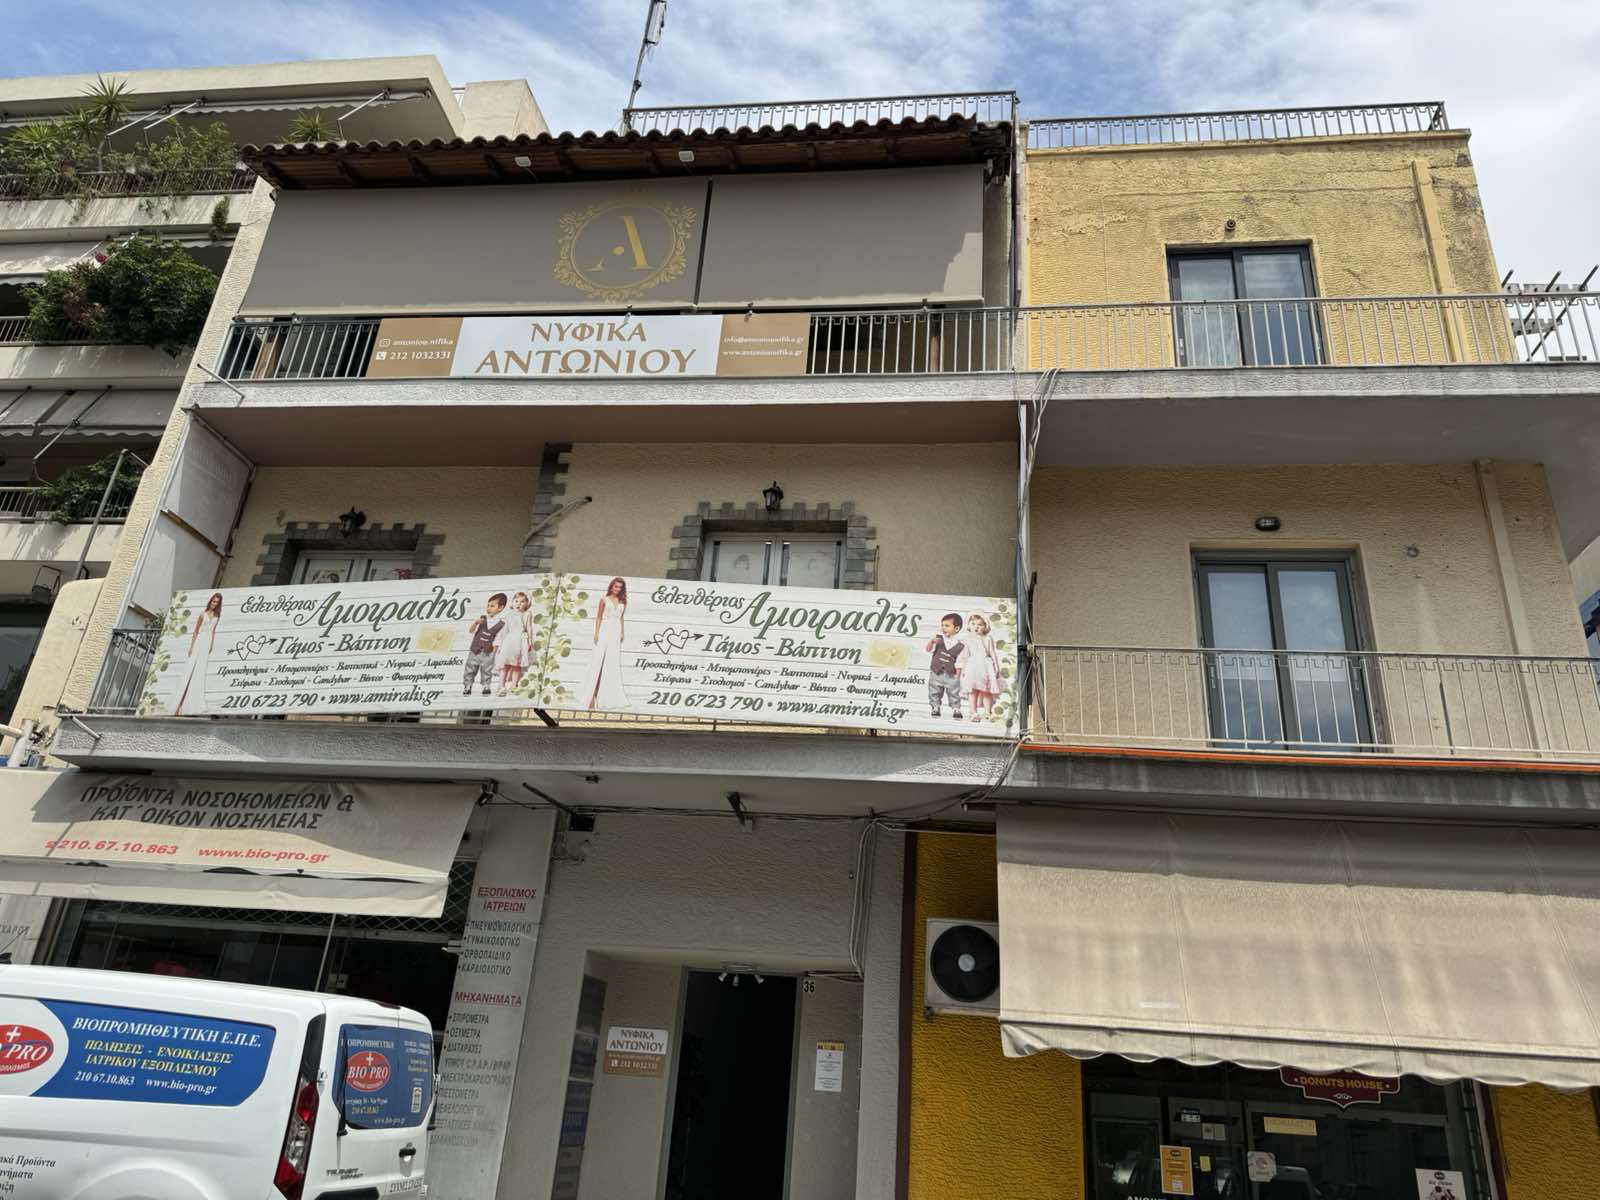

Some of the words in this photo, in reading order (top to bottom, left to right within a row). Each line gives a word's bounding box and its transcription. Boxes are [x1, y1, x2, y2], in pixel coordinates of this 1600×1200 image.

[531, 322, 647, 342] ΝΥΦΙΚΑ
[389, 351, 408, 361] 212
[411, 350, 452, 360] 1032331
[474, 348, 697, 374] ΑΝΤΩΝΙΟΥ
[293, 585, 471, 638] Αμοιραλής
[720, 591, 923, 640] Αμοιραλής
[274, 635, 325, 659] Γάμος
[335, 633, 412, 655] Βάπτιση
[702, 633, 761, 659] Γάμος
[775, 637, 862, 664] Βάπτιση
[384, 659, 416, 670] Νυφικά
[424, 656, 463, 669] Λαμπάδες
[634, 658, 698, 673] Προσκλητήρια
[706, 662, 772, 677] Μπομπονιέρες
[780, 667, 829, 679] Βαπτιστικά
[837, 670, 872, 683] Νυφικά
[880, 673, 926, 686] Λαμπάδες
[313, 674, 352, 686] Candybar
[653, 673, 692, 685] Στέφανα
[754, 679, 800, 693] Candybar
[809, 682, 837, 693] Βίντεο
[846, 684, 907, 699] Φωτογράφιση
[221, 694, 251, 709] 210
[251, 693, 288, 708] 6723
[287, 692, 319, 707] 790
[328, 685, 444, 706] www.amiralis.gr
[647, 690, 682, 706] 210
[684, 693, 727, 709] 6723
[730, 695, 764, 711] 790
[777, 699, 910, 724] www.amiralis.gr
[80, 785, 174, 805] ΠΡΟΪΟΝΤΑ
[181, 790, 331, 812] ΝΟΣΟΚΟΜΕΙΩΝ
[210, 810, 323, 830] ΝΟΣΗΛΕΙΑΣ
[198, 847, 330, 864] www.bio-pro.gr
[477, 886, 537, 899] ΕΞΟΠΛΙΣΜΟΣ
[483, 900, 527, 912] ΙΑΤΡΕΙΩΝ
[467, 934, 521, 947] ΓΥΝΑΙΚΟΛΟΓΙΚΟ
[464, 949, 511, 961] ΟΡΘΟΠΑΙΔΙΚΟ
[461, 963, 512, 976] ΚΑΡΔΙΟΛΟΓΙΚΟ
[803, 980, 815, 993] 36
[454, 991, 522, 1006] ΜΗΧΑΝΗΜΑΤΑ
[73, 1016, 218, 1043] ΒΙΟΠΡΟΜΗΘΕΥΤΙΚΗ
[220, 1031, 262, 1048] Ε.Π.Ε.
[620, 1029, 655, 1040] ΝΥΦΙΚΑ
[4, 1043, 48, 1061] PRO
[84, 1039, 145, 1055] ΠΩΛΗΣΕΙΣ
[156, 1046, 234, 1064] ΕΝΟΙΚΙΑΣΕΙΣ
[609, 1040, 665, 1052] ΑΝΤΩΝΙΟΥ
[86, 1054, 141, 1069] ΙΑΤΡΙΚΟΥ
[140, 1060, 221, 1078] ΕΞΟΠΛΙΣΜΟΥ
[348, 1066, 368, 1079] BIO
[370, 1066, 388, 1079] PRO
[74, 1070, 93, 1082] 210
[92, 1071, 135, 1086] 67.10.863
[145, 1077, 217, 1096] www.bio-pro.gr
[1300, 1076, 1345, 1088] DONUTS
[1345, 1079, 1385, 1090] HOUSE
[16, 1155, 56, 1168] Προϊόντα
